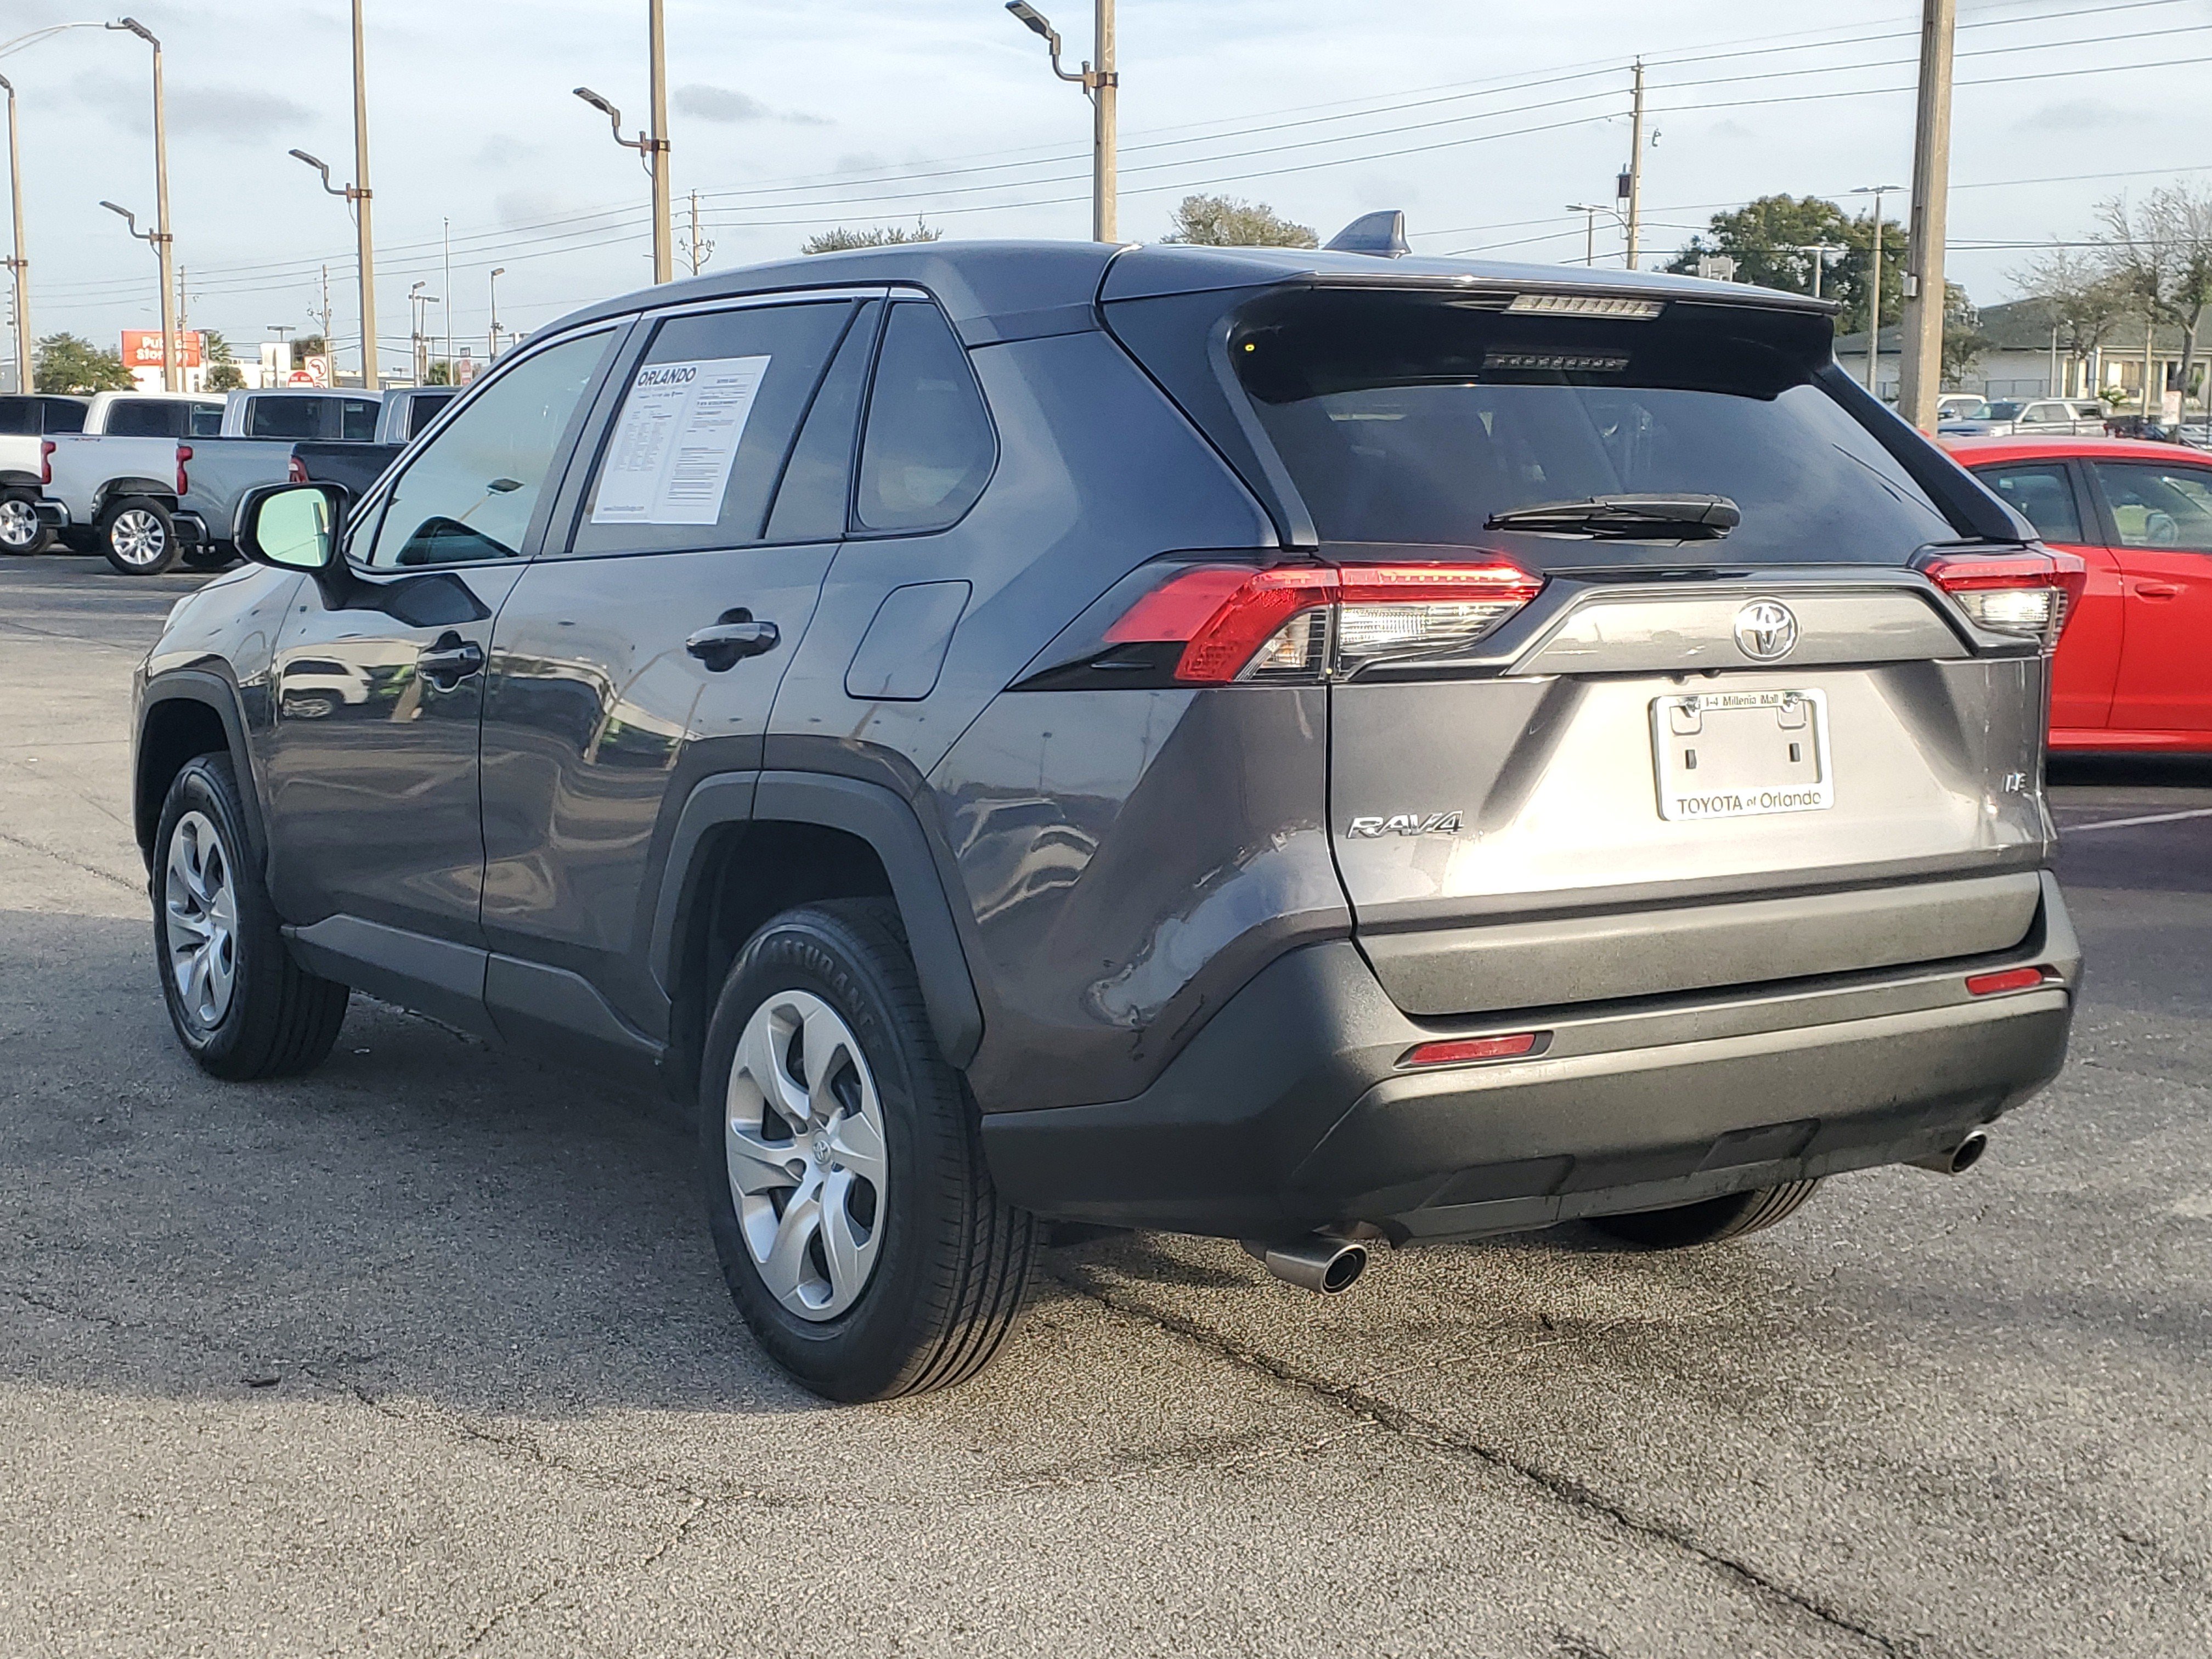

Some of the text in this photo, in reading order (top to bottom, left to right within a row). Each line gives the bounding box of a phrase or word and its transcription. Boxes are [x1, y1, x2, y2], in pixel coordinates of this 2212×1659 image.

[638, 367, 697, 386] ORLANDO
[1722, 695, 1757, 706] Millenia
[1759, 694, 1779, 704] Mall
[1677, 790, 1821, 814] TOYOTA of Orlando
[1346, 810, 1465, 839] RAV4
